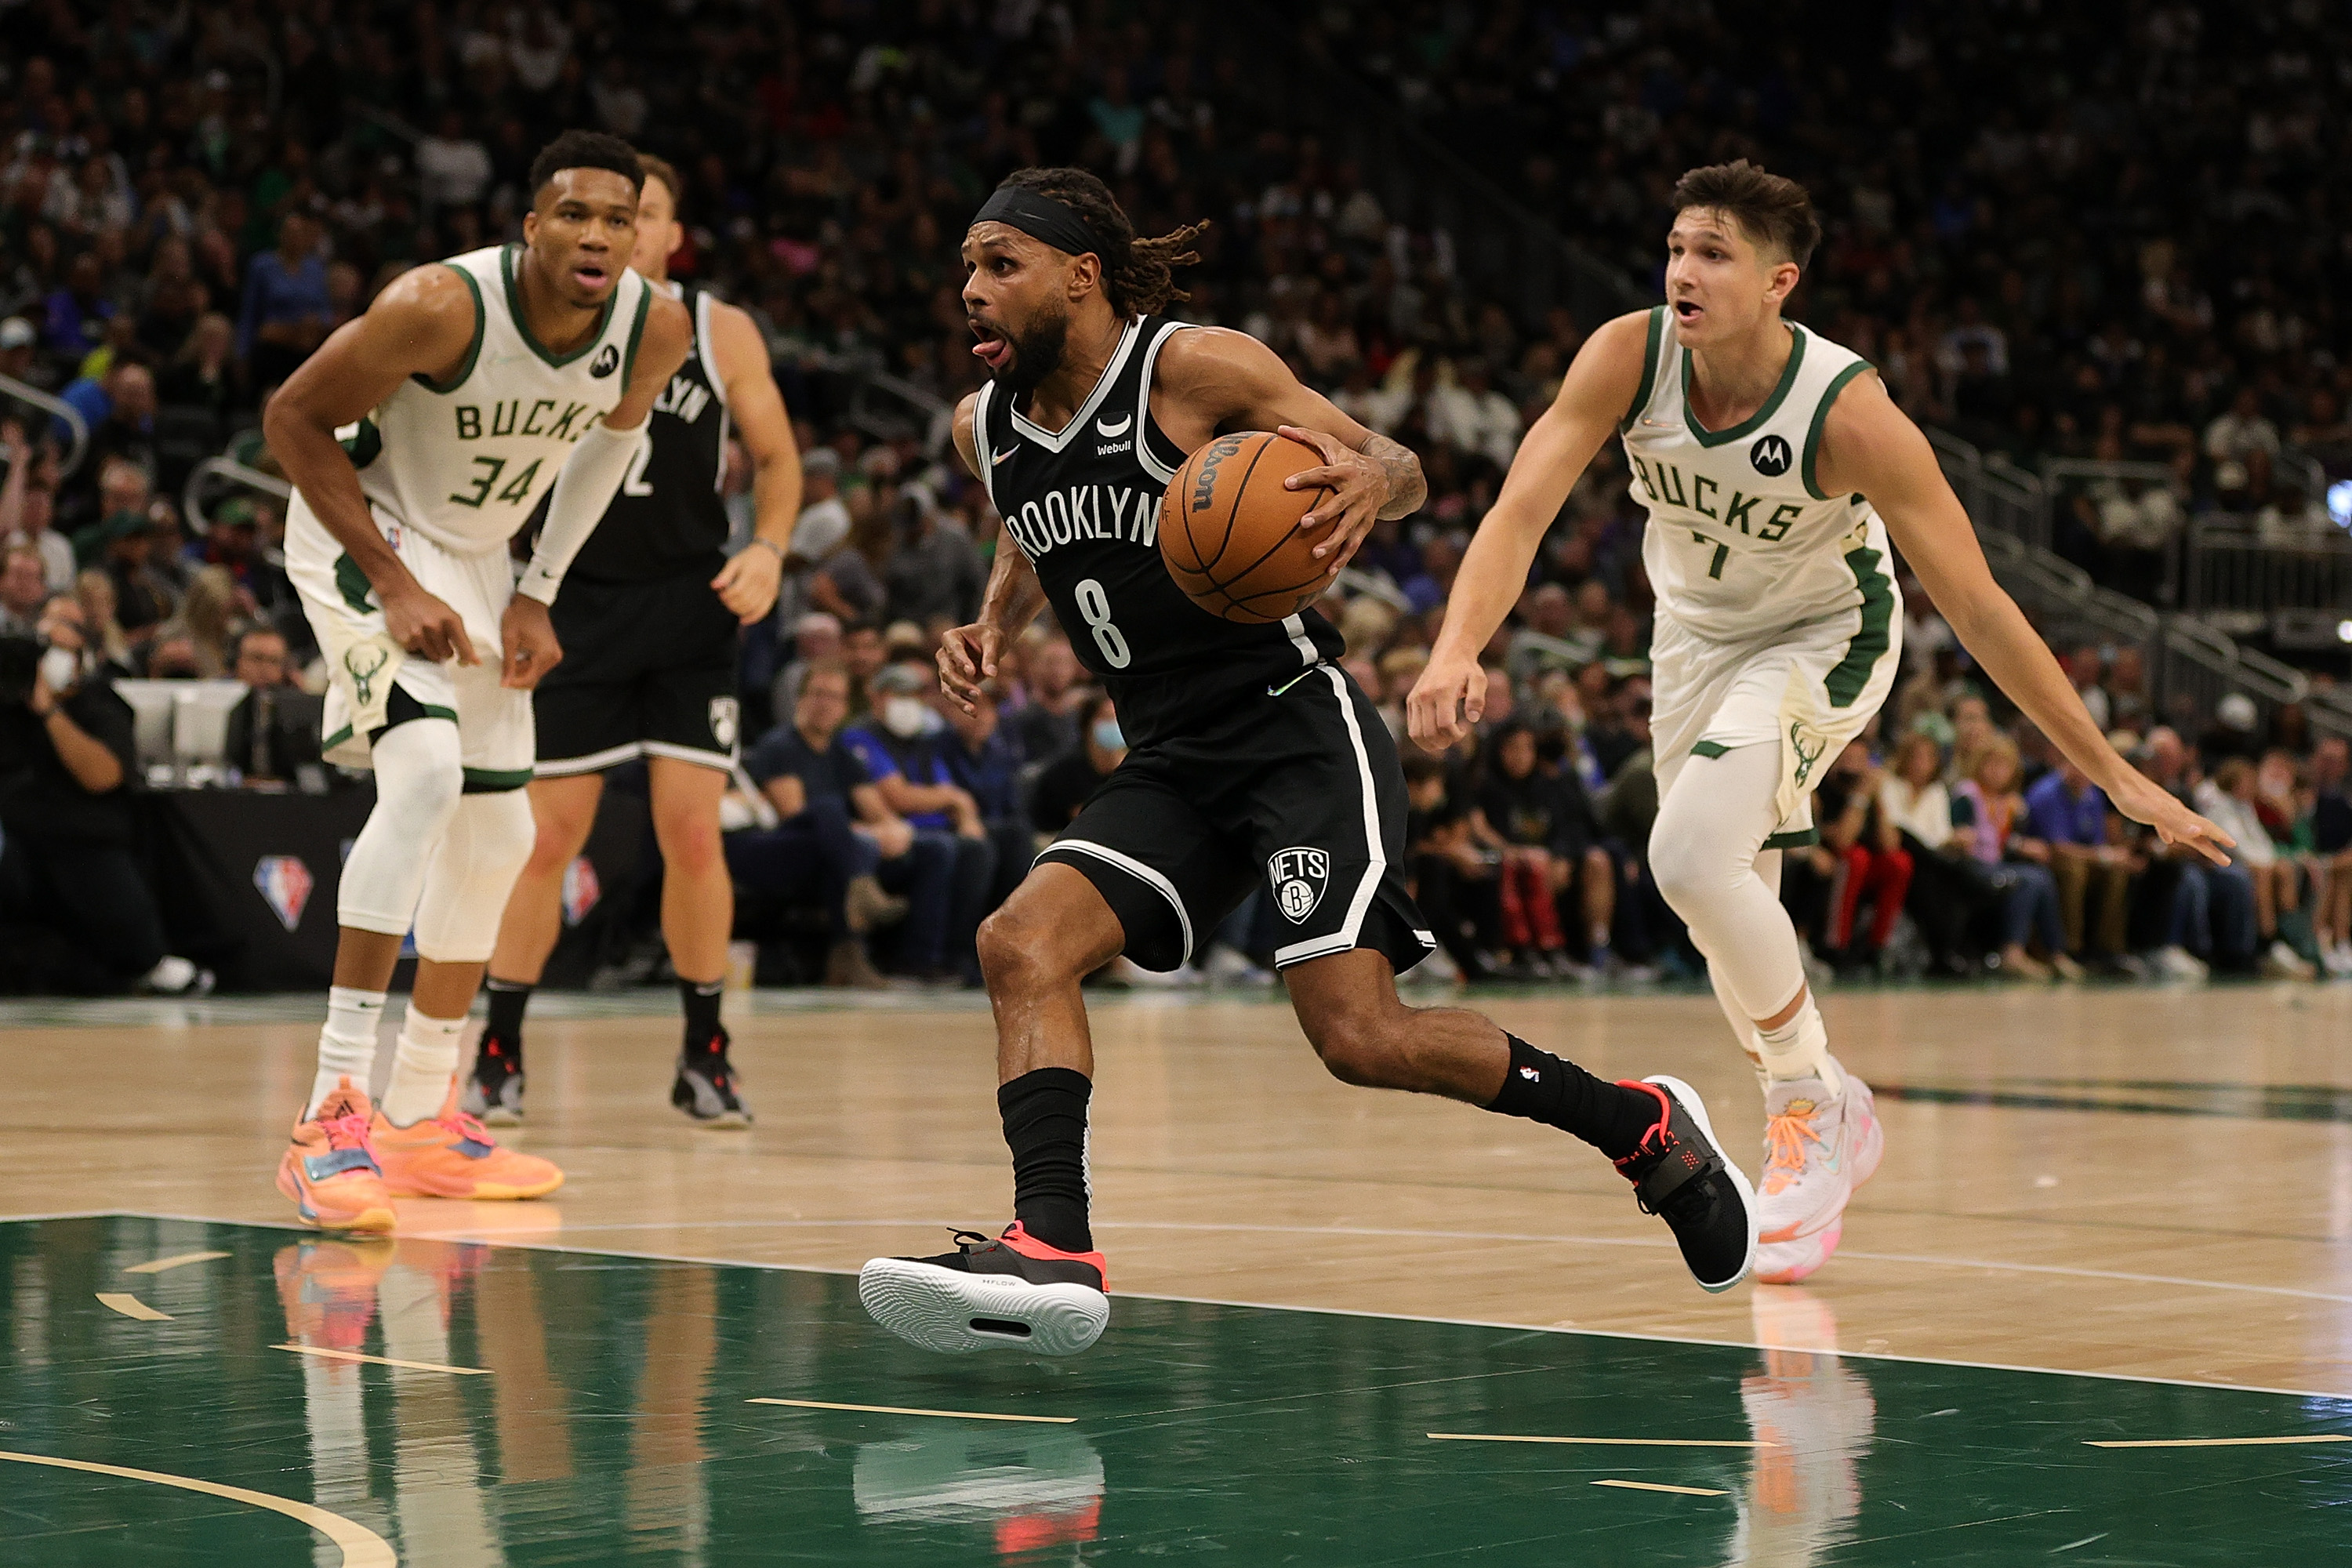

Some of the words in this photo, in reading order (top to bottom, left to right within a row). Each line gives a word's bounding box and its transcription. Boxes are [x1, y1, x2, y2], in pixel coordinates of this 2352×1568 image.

[1098, 440, 1131, 456] Webull
[448, 456, 544, 508] 34
[1632, 453, 1803, 542] BUCKS
[1006, 485, 1163, 564] ROOKLYN
[1691, 530, 1730, 581] 7
[1075, 579, 1131, 670] 8
[1269, 851, 1326, 889] NETS
[1290, 886, 1302, 913] B
